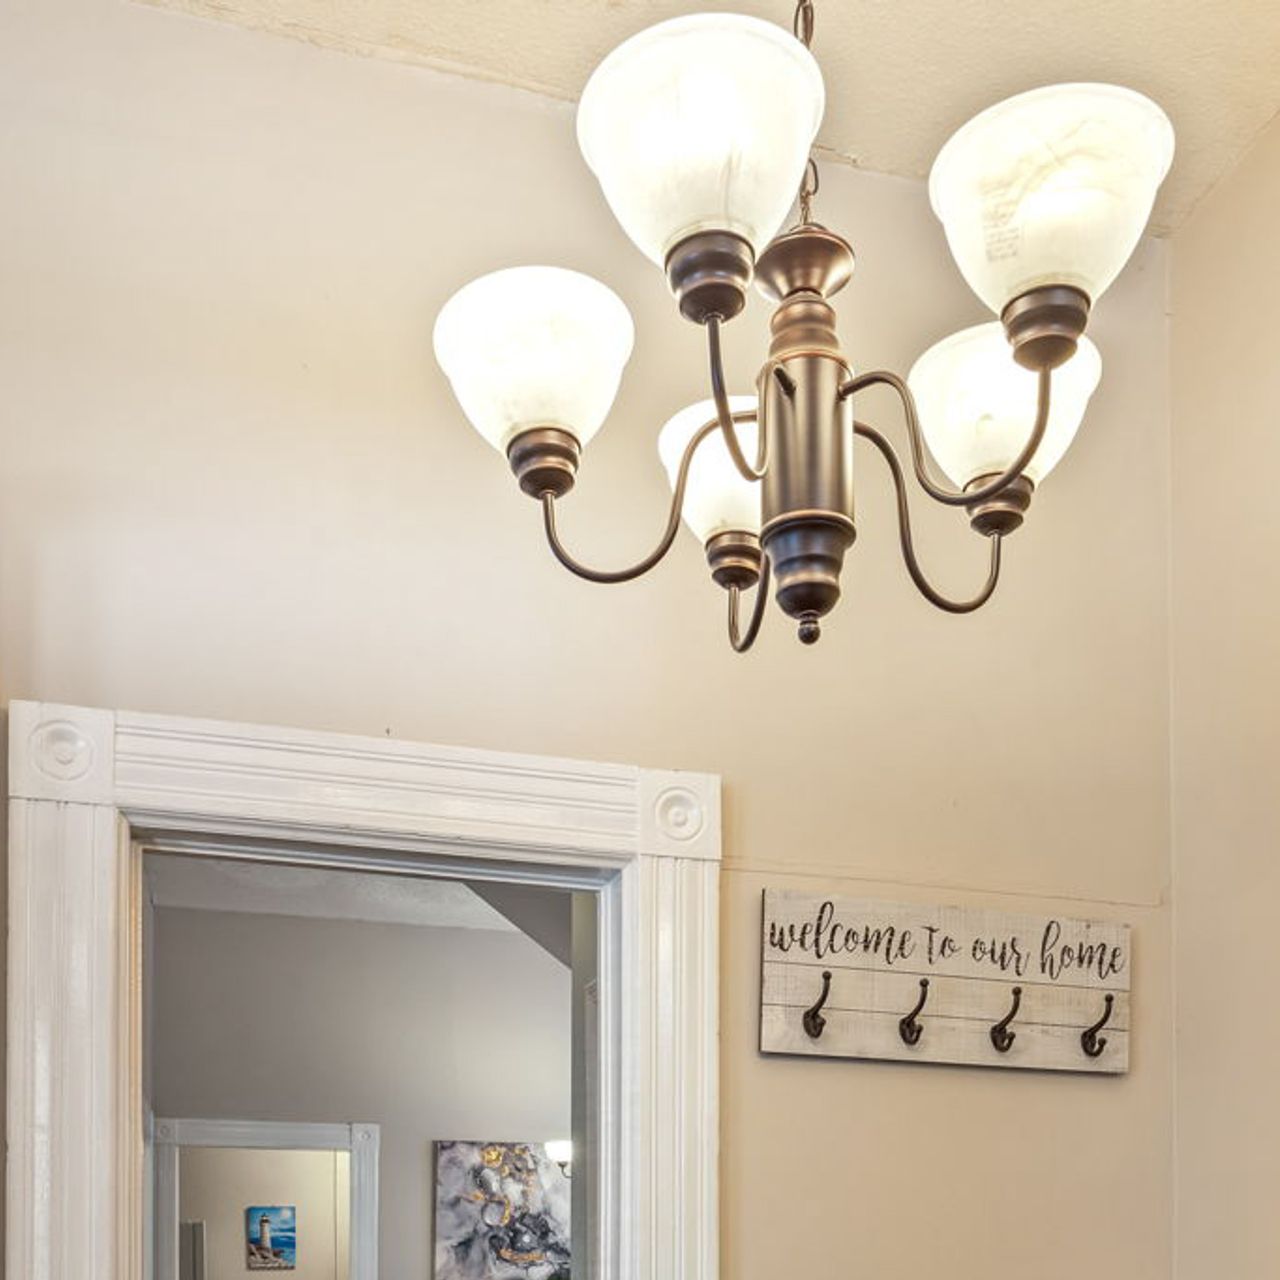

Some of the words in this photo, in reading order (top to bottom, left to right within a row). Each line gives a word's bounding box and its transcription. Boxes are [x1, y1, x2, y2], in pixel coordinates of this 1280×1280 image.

[769, 901, 917, 965] welcome
[921, 926, 962, 965] to
[971, 934, 1030, 977] our
[1040, 920, 1125, 980] home
